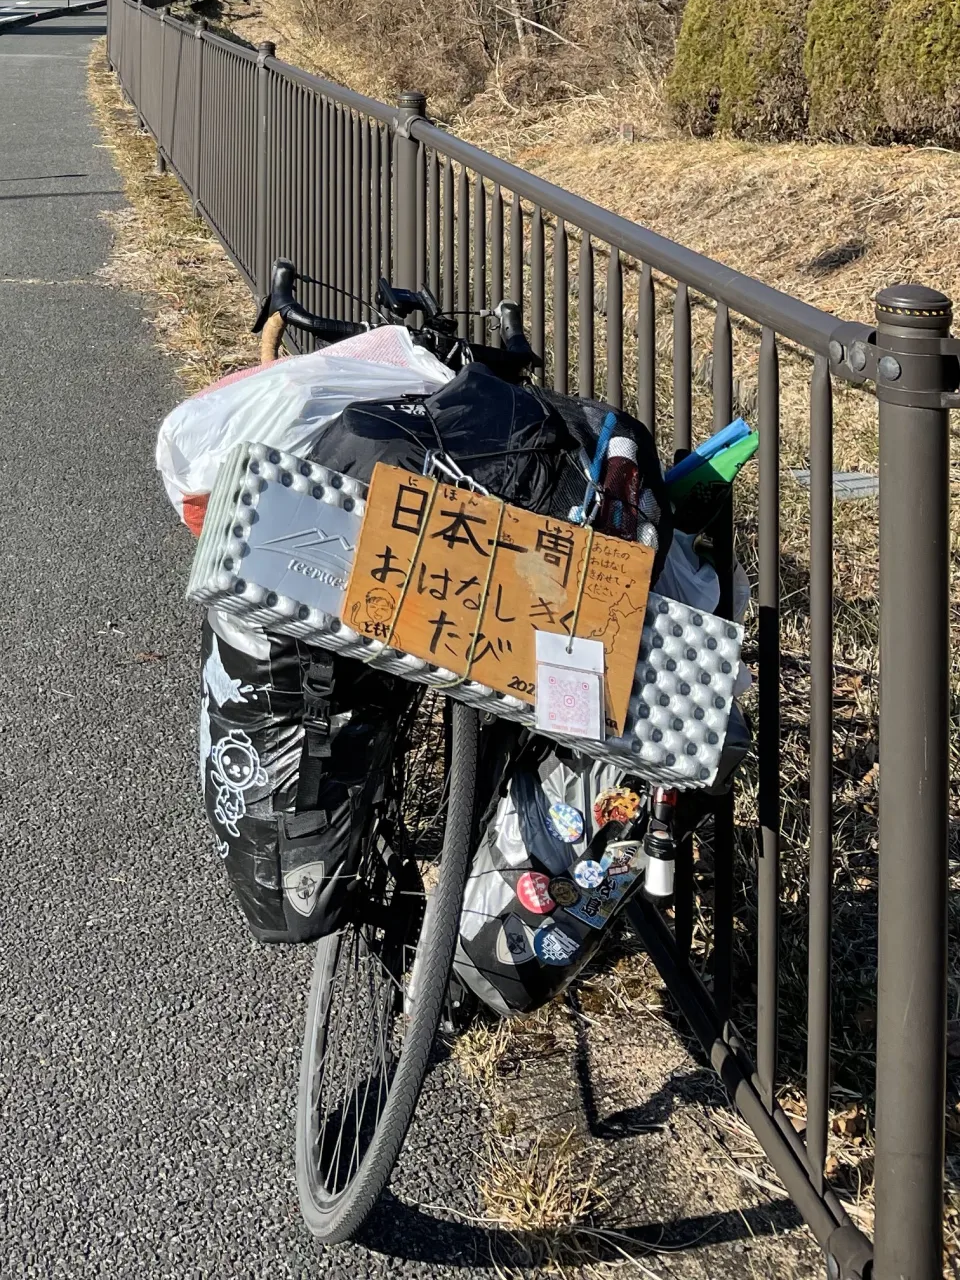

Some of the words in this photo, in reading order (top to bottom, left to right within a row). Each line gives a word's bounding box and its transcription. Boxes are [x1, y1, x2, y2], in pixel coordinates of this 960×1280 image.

[392, 484, 575, 588] 日本一周
[592, 544, 630, 560] あなたの
[590, 558, 627, 574] おはなし
[587, 583, 619, 596] ください
[364, 621, 392, 638] ともや
[428, 610, 513, 662] たび
[508, 675, 536, 695] 202
